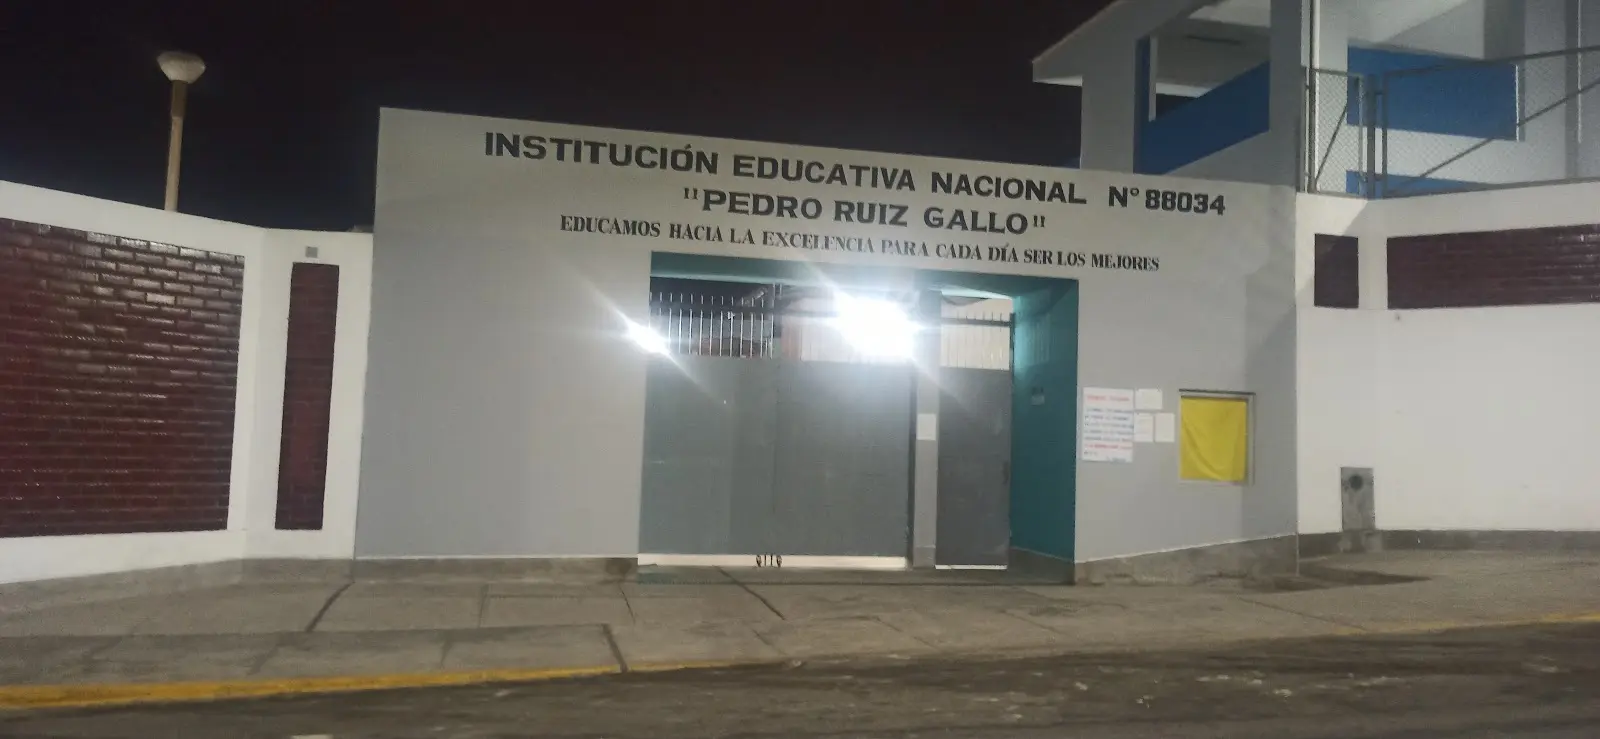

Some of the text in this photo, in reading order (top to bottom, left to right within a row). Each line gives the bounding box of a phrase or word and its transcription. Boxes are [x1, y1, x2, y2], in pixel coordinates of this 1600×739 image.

[485, 132, 718, 175] INSTITUCIÓN
[733, 154, 916, 192] EDUCATIVA
[931, 171, 1087, 205] NACIONAL
[1145, 189, 1226, 216] 88034
[834, 200, 909, 227] RUIZ
[560, 215, 1160, 272] EDUCAMOS HACIA LA EXCELENCIA PARA CADA DÍA SER LOS MEJORES
